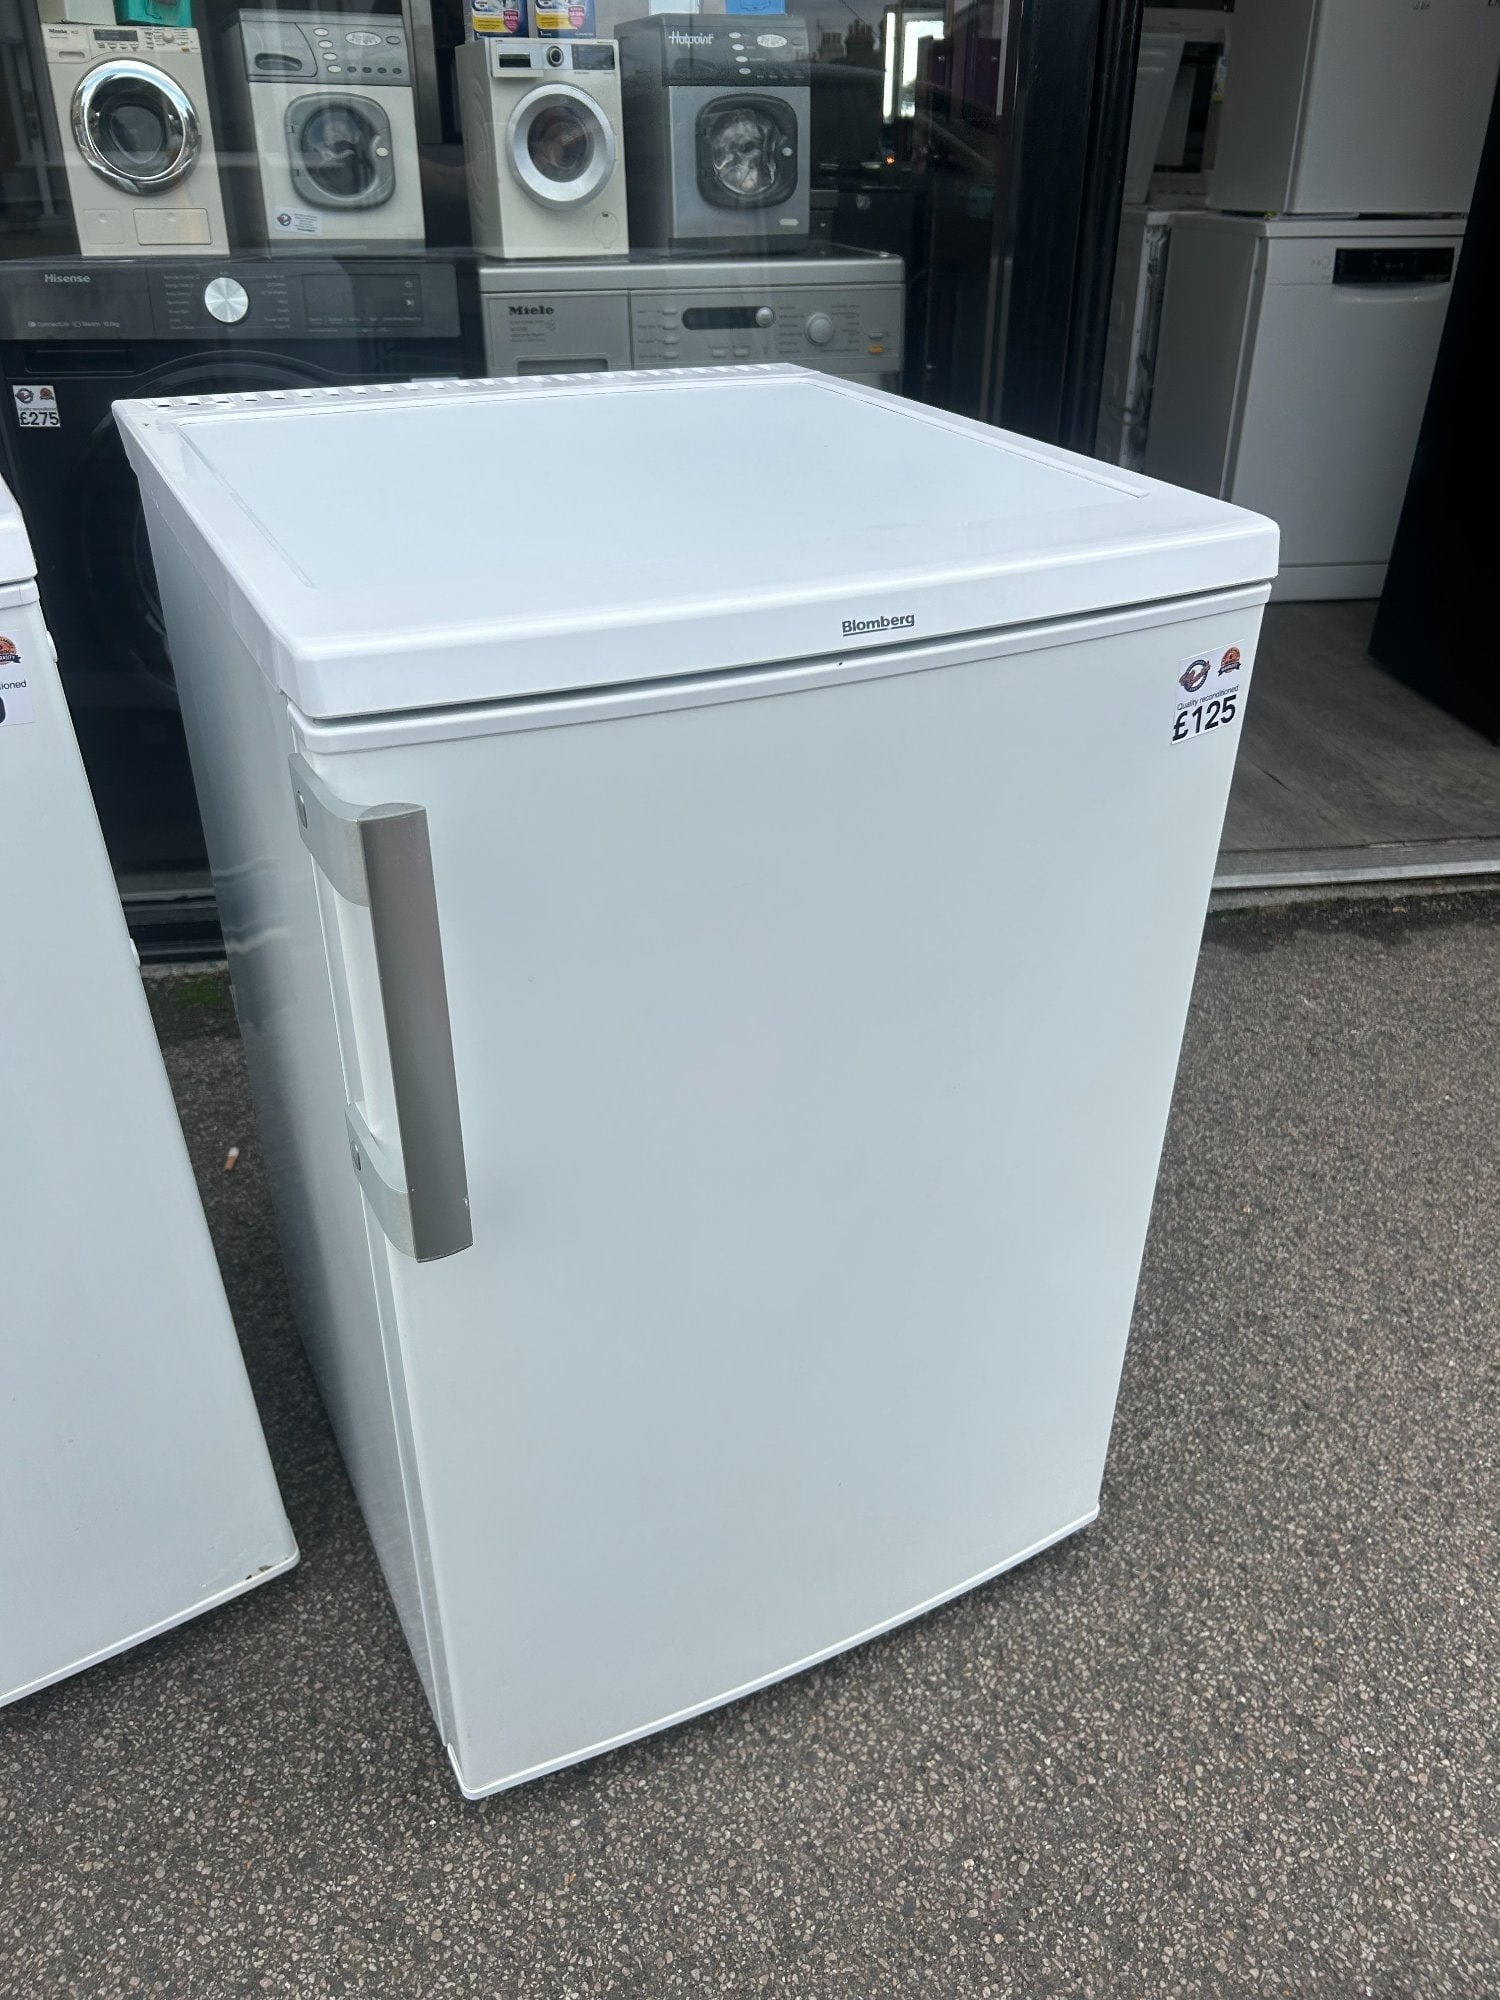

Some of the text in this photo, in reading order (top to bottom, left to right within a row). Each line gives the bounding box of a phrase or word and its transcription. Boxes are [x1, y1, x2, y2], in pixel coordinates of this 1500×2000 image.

[669, 31, 714, 47] Hotpoint
[45, 274, 91, 283] Hisense
[508, 305, 554, 315] Miele
[20, 412, 59, 425] £275
[842, 615, 915, 636] Blomberg
[1176, 684, 1240, 711] Quality reconditioned
[1172, 694, 1237, 741] £125
